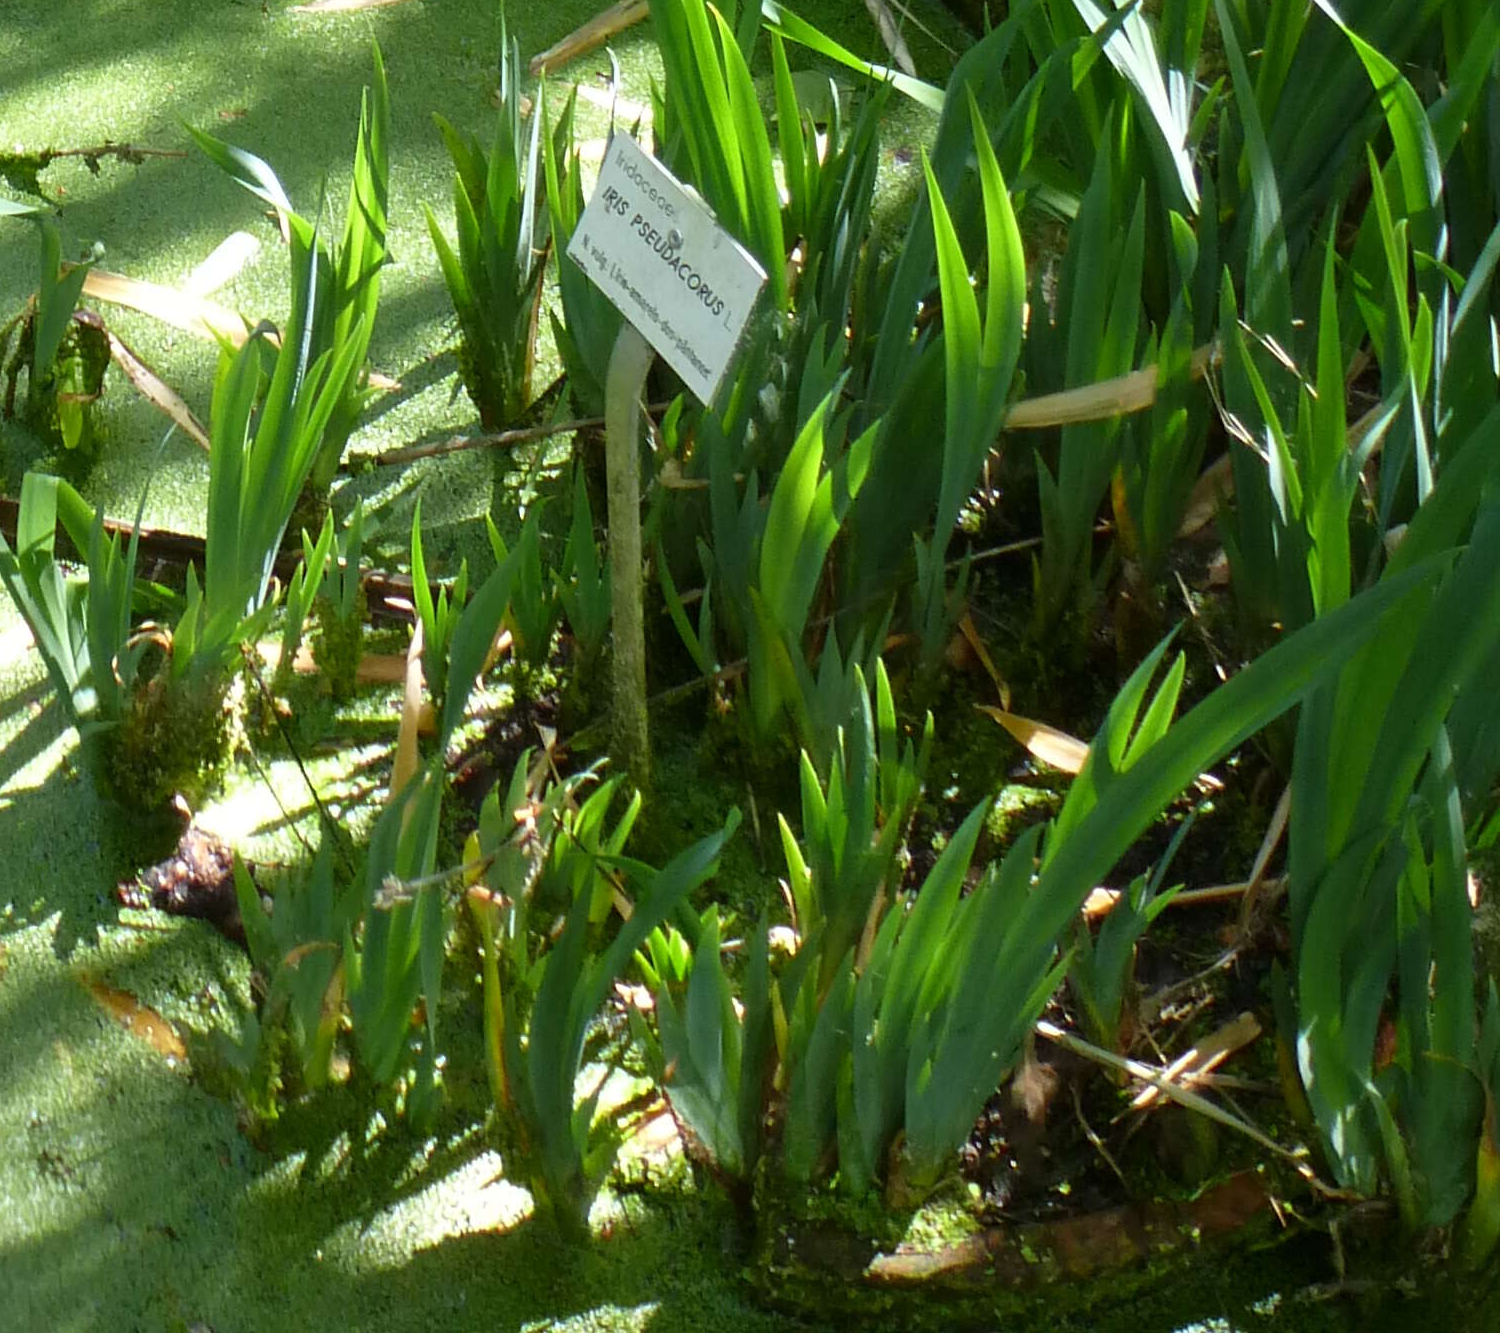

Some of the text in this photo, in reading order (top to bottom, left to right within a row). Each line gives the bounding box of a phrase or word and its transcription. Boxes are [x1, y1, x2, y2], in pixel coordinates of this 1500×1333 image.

[615, 150, 674, 217] Iridaceae
[602, 186, 629, 216] IRIS
[631, 213, 724, 316] PSEUDACORUS
